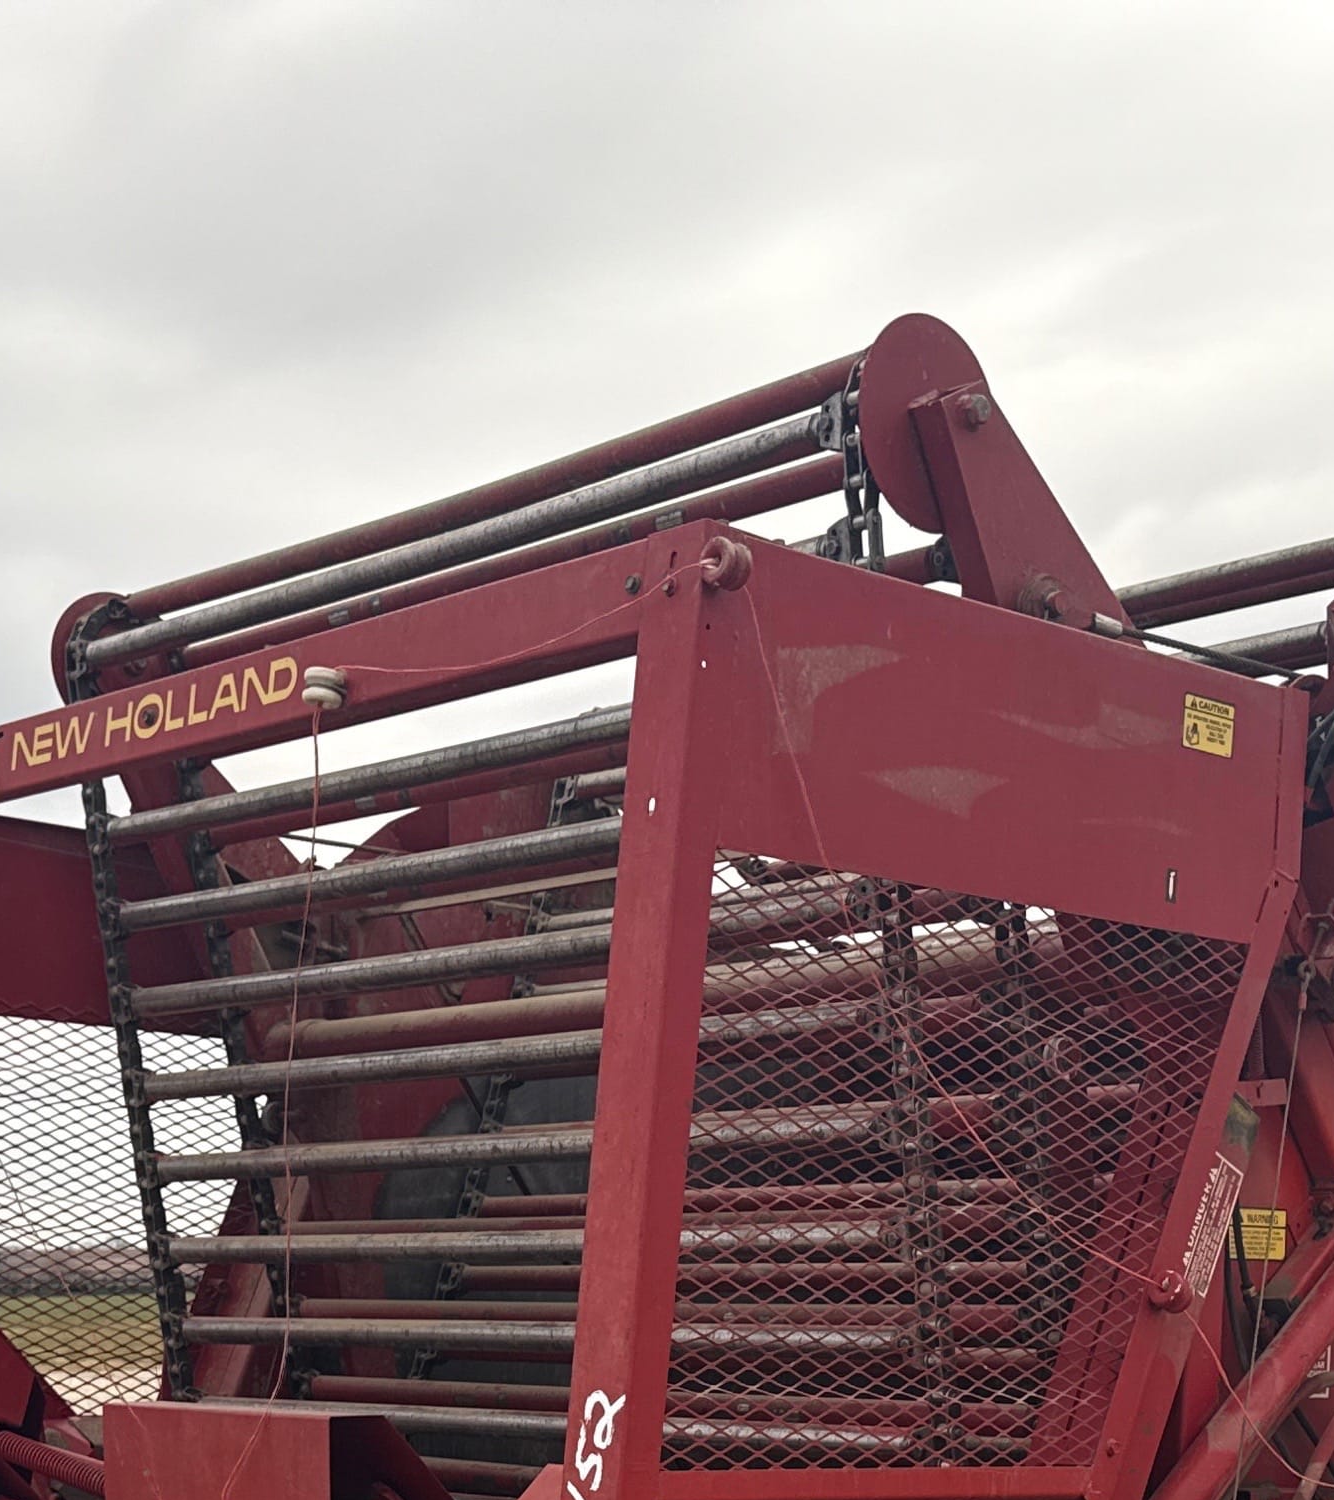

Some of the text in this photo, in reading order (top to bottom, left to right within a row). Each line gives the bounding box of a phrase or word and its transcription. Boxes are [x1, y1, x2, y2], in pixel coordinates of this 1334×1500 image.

[11, 656, 298, 771] NEW HOLLAND
[1199, 701, 1230, 715] CAUTION
